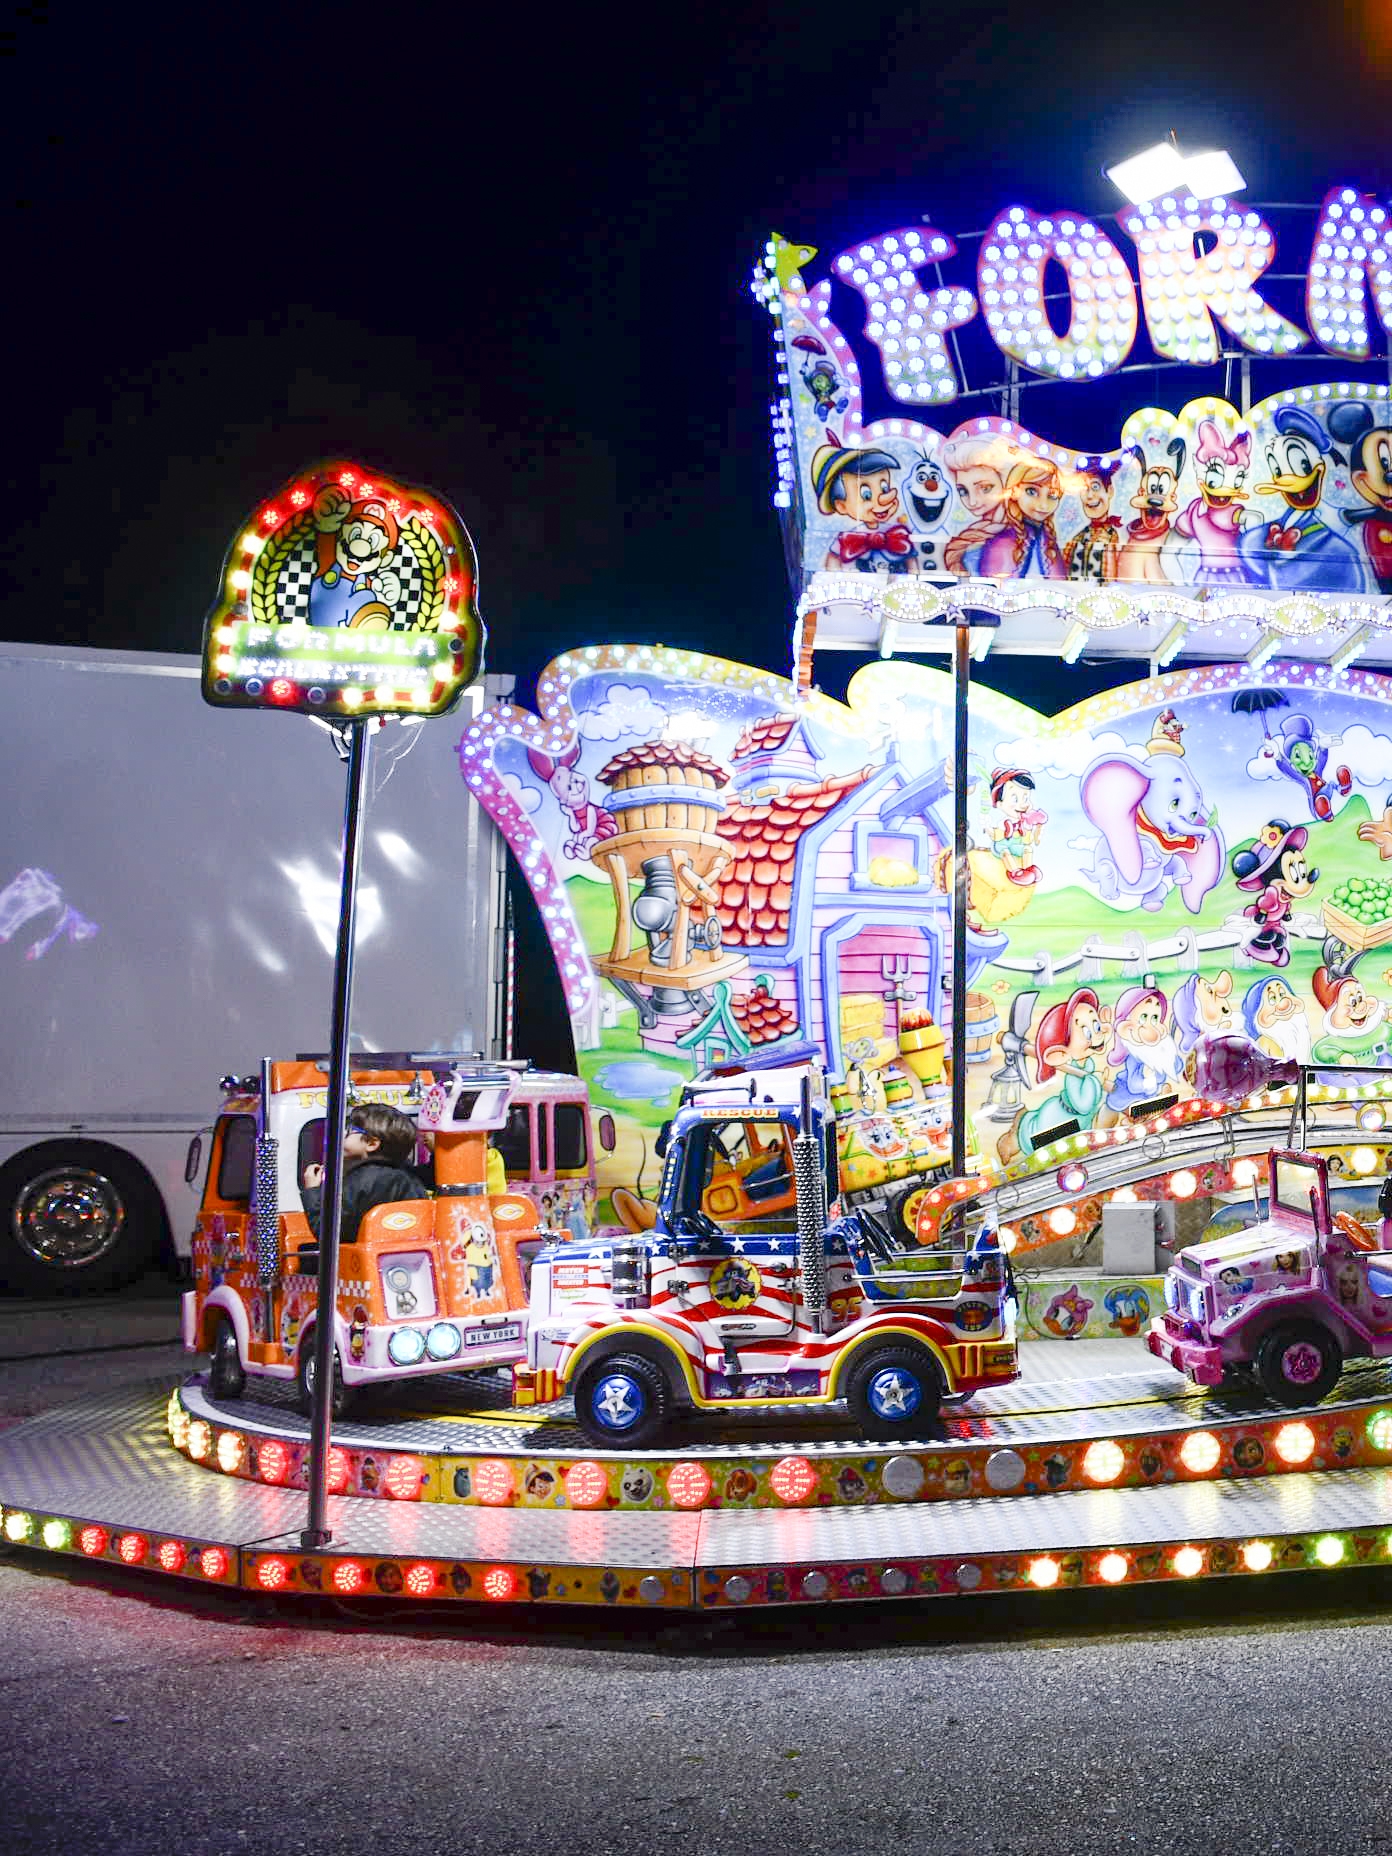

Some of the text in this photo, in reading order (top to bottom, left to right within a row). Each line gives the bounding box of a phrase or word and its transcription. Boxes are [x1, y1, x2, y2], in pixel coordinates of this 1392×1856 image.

[247, 626, 438, 656] FORMULA
[702, 1108, 778, 1118] RESCUE
[829, 1296, 866, 1321] 95
[470, 1328, 516, 1342] NEW YORK
